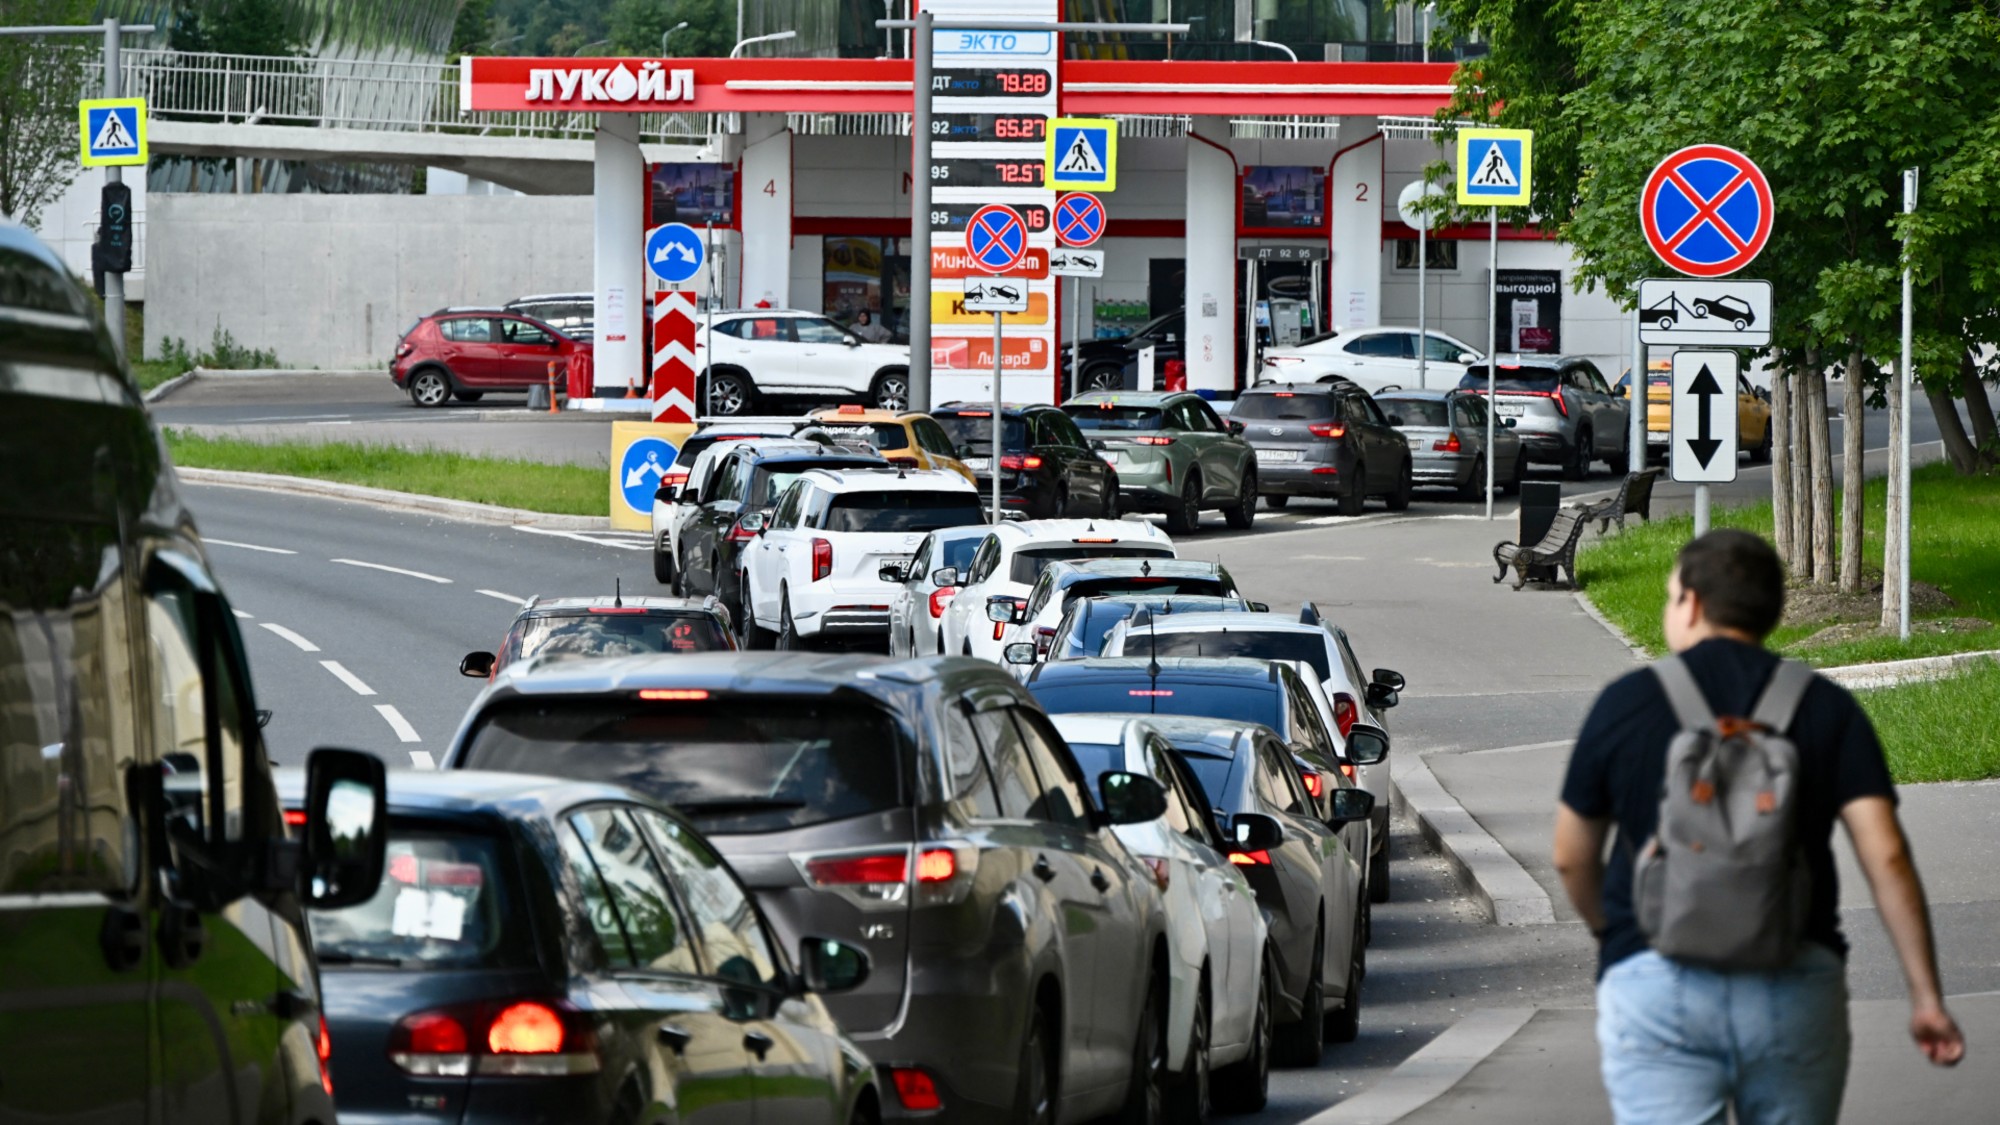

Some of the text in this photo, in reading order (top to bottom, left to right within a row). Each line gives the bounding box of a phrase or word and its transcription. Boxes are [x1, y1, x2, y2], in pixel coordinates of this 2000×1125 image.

[960, 34, 1017, 50] ЭКТО
[525, 61, 695, 102] ЛУКОЙЛ
[932, 76, 952, 91] ДТ
[996, 74, 1047, 92] 79.28
[932, 121, 949, 134] 92
[995, 119, 1045, 137] 65.27
[931, 164, 1045, 182] 95 72.57
[763, 179, 777, 197] 4
[1355, 183, 1369, 202] 2
[931, 211, 949, 225] 95
[933, 252, 1040, 270] Миниет
[1258, 248, 1311, 259] ДТ 92 95
[1496, 282, 1556, 294] выгодно!
[977, 351, 1031, 368] Лиард
